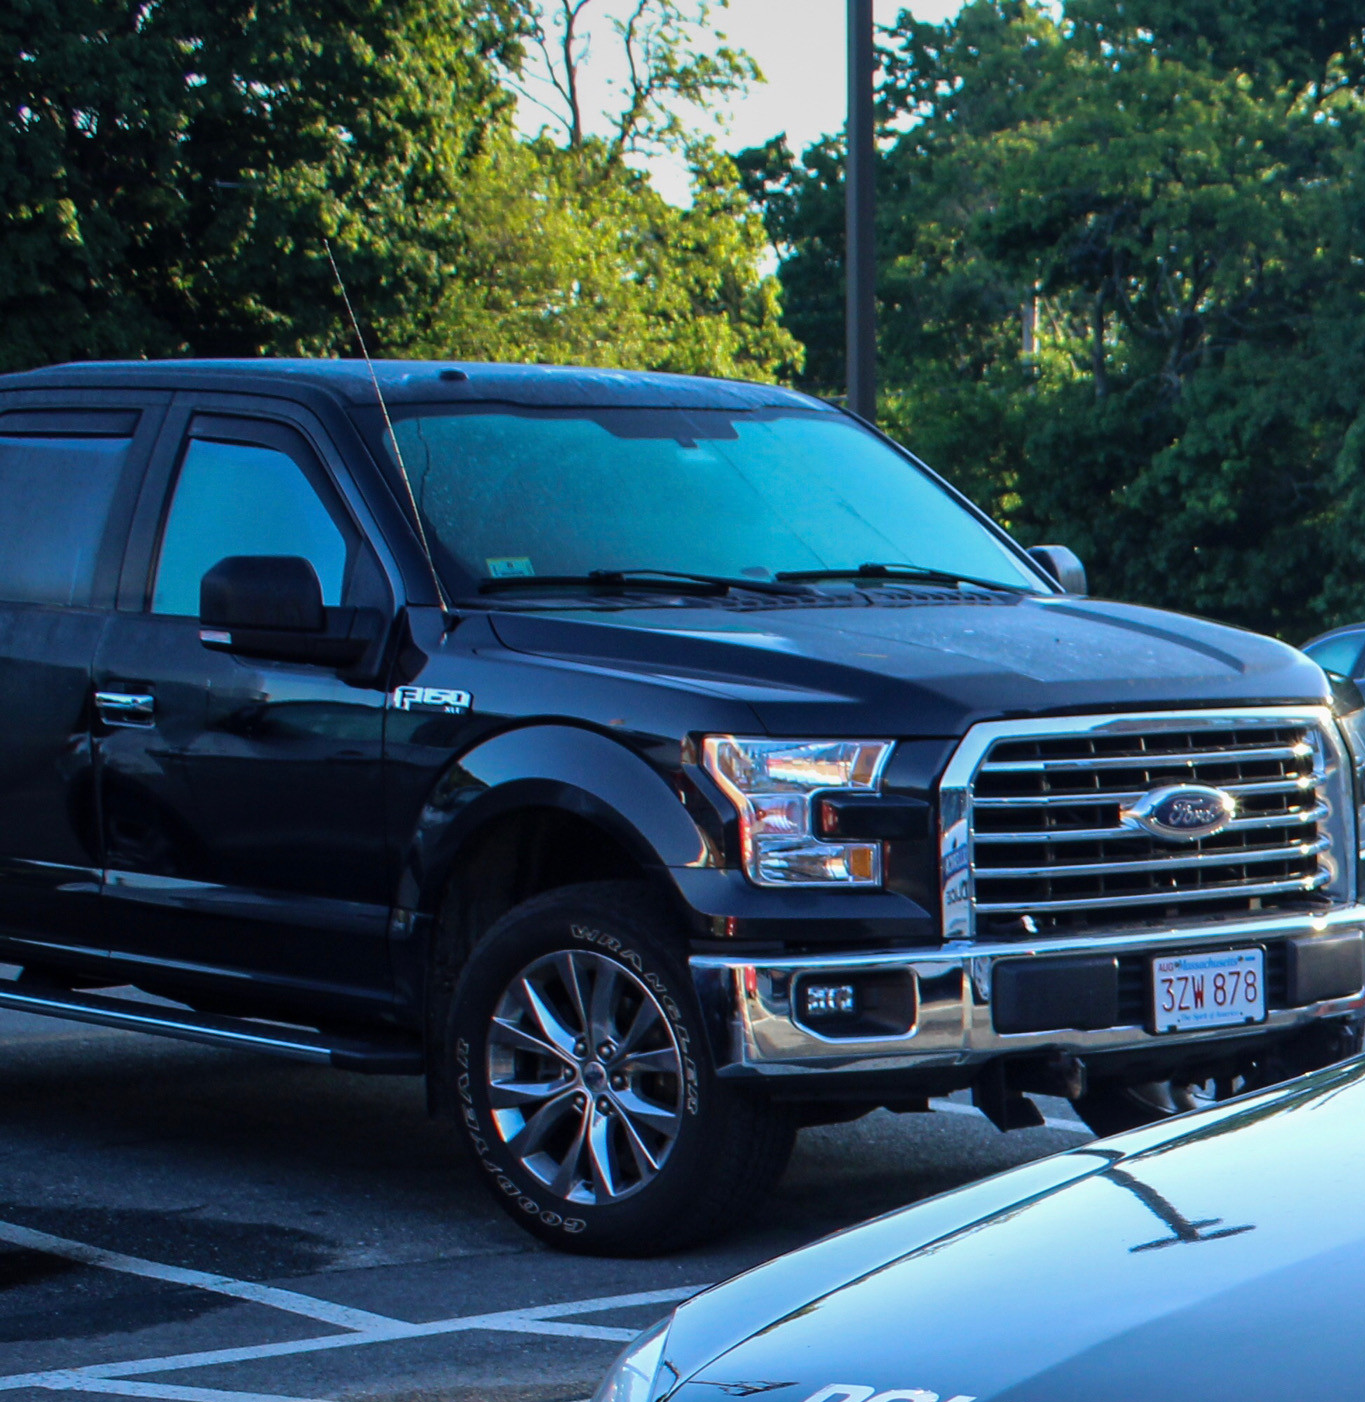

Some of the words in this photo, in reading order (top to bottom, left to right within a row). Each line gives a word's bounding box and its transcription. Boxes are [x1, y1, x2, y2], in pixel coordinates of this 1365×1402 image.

[571, 924, 698, 1115] WRANGLER
[1161, 975, 1206, 1012] 3ZW
[1213, 970, 1257, 1006] 878
[456, 1038, 586, 1233] GOODYEAR
